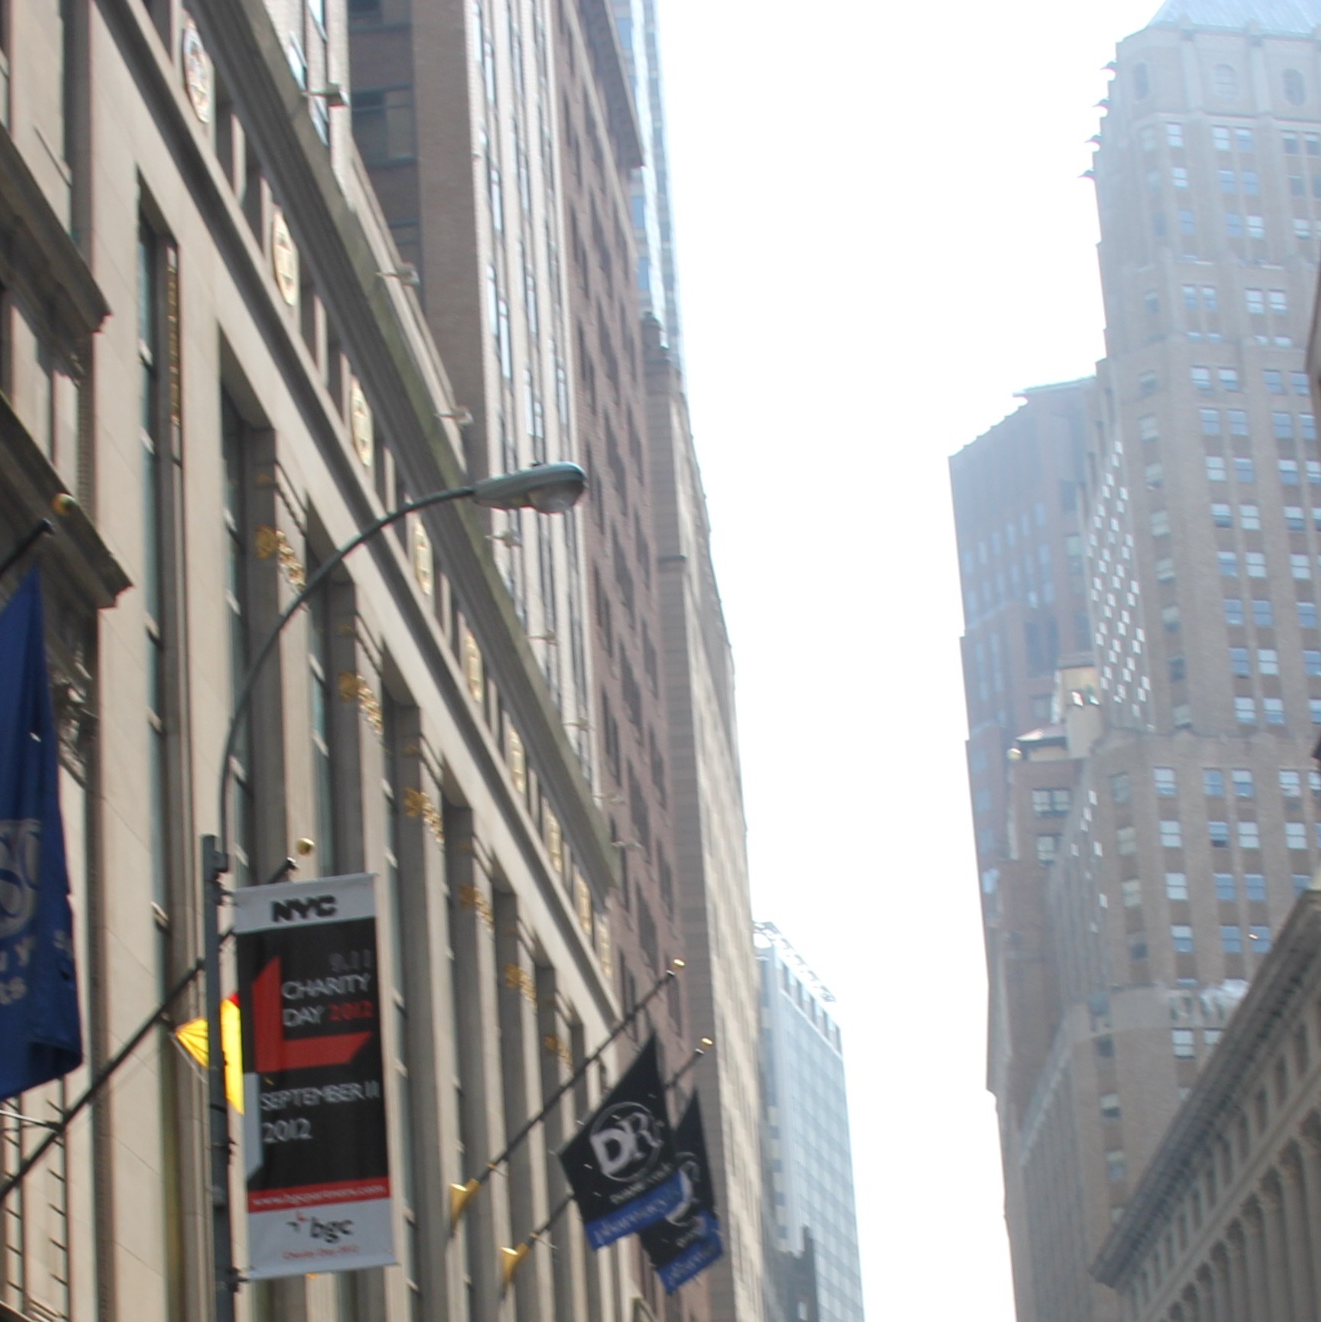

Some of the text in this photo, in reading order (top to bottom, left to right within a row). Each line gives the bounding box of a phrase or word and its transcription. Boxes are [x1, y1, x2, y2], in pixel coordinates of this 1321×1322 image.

[272, 895, 338, 922] NYC
[281, 972, 372, 1000] CHARITY
[283, 1005, 325, 1027] DAY
[260, 1082, 365, 1111] SEPTEMBER
[262, 1117, 313, 1143] 2012
[310, 1217, 356, 1244] bgc
